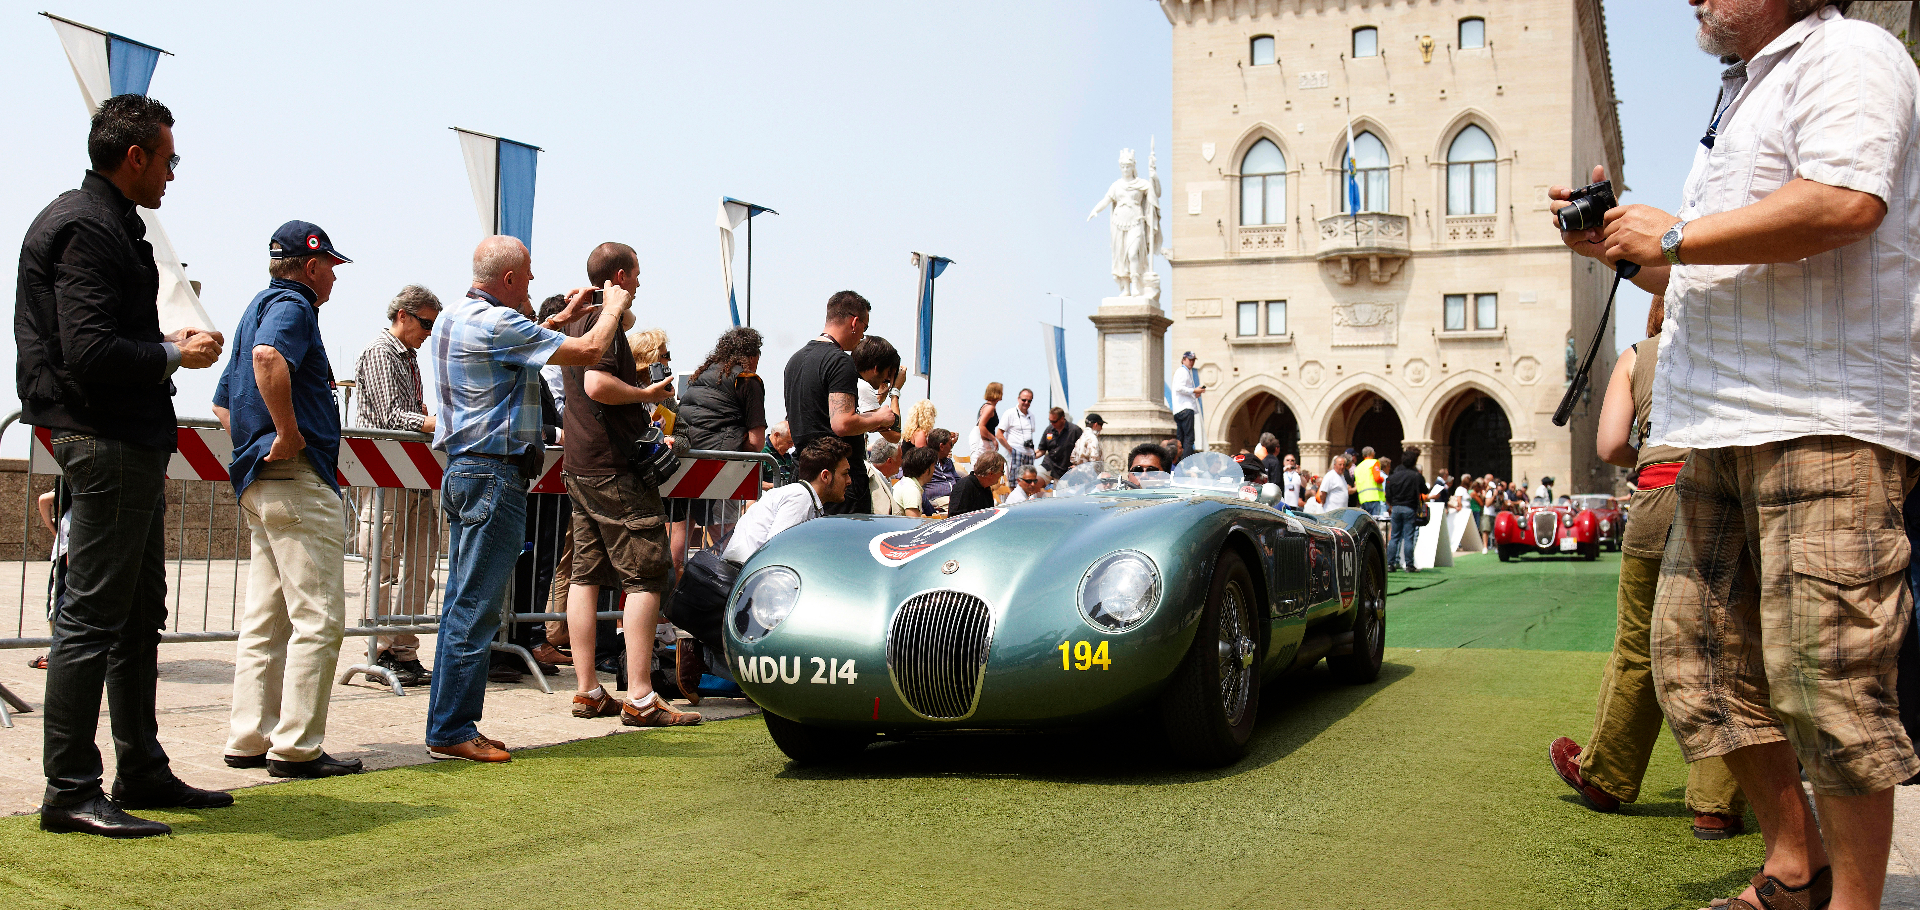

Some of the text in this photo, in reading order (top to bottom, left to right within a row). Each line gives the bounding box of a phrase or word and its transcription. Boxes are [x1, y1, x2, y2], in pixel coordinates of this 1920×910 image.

[1341, 551, 1353, 577] 194
[738, 655, 859, 685] MDU 214
[1058, 640, 1112, 671] 194
